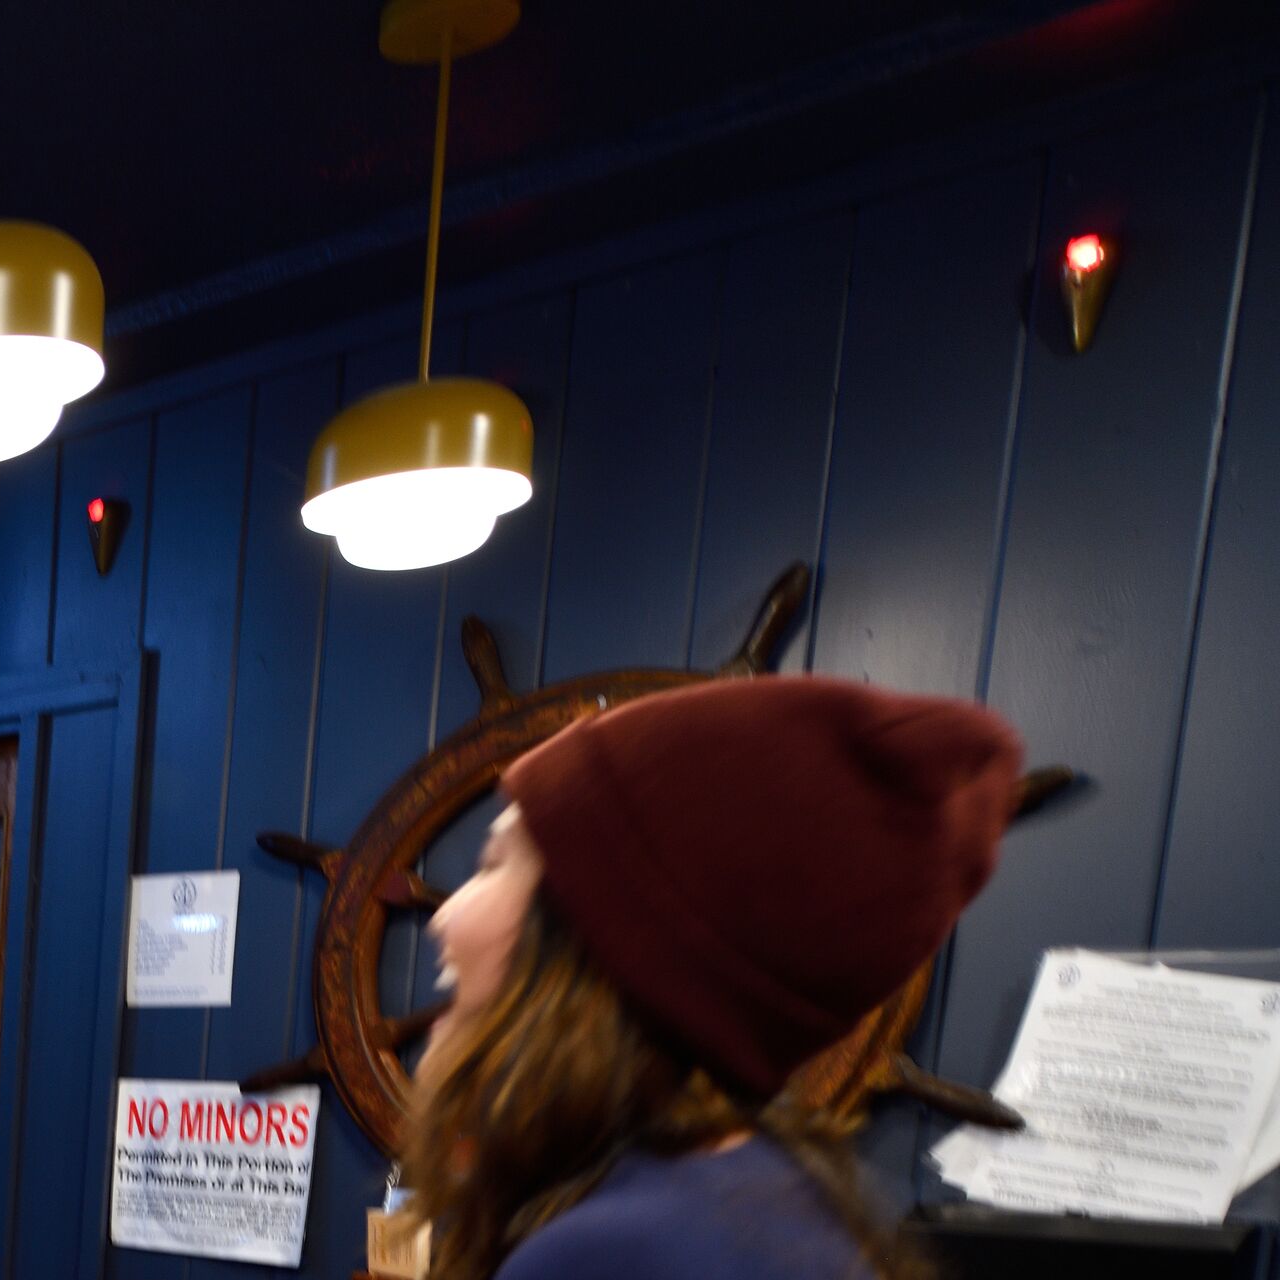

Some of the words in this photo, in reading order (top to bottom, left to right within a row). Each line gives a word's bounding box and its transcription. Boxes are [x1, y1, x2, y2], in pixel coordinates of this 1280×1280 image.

[128, 1097, 169, 1139] NO
[179, 1098, 310, 1147] MINORS
[117, 1146, 182, 1165] Permitted
[204, 1151, 233, 1168] This
[239, 1152, 293, 1174] Portion
[298, 1158, 310, 1176] of
[119, 1167, 142, 1182] The
[145, 1169, 206, 1188] Premises
[212, 1177, 225, 1191] or
[231, 1177, 244, 1192] at
[250, 1178, 279, 1195] This
[284, 1180, 306, 1197] Bar
